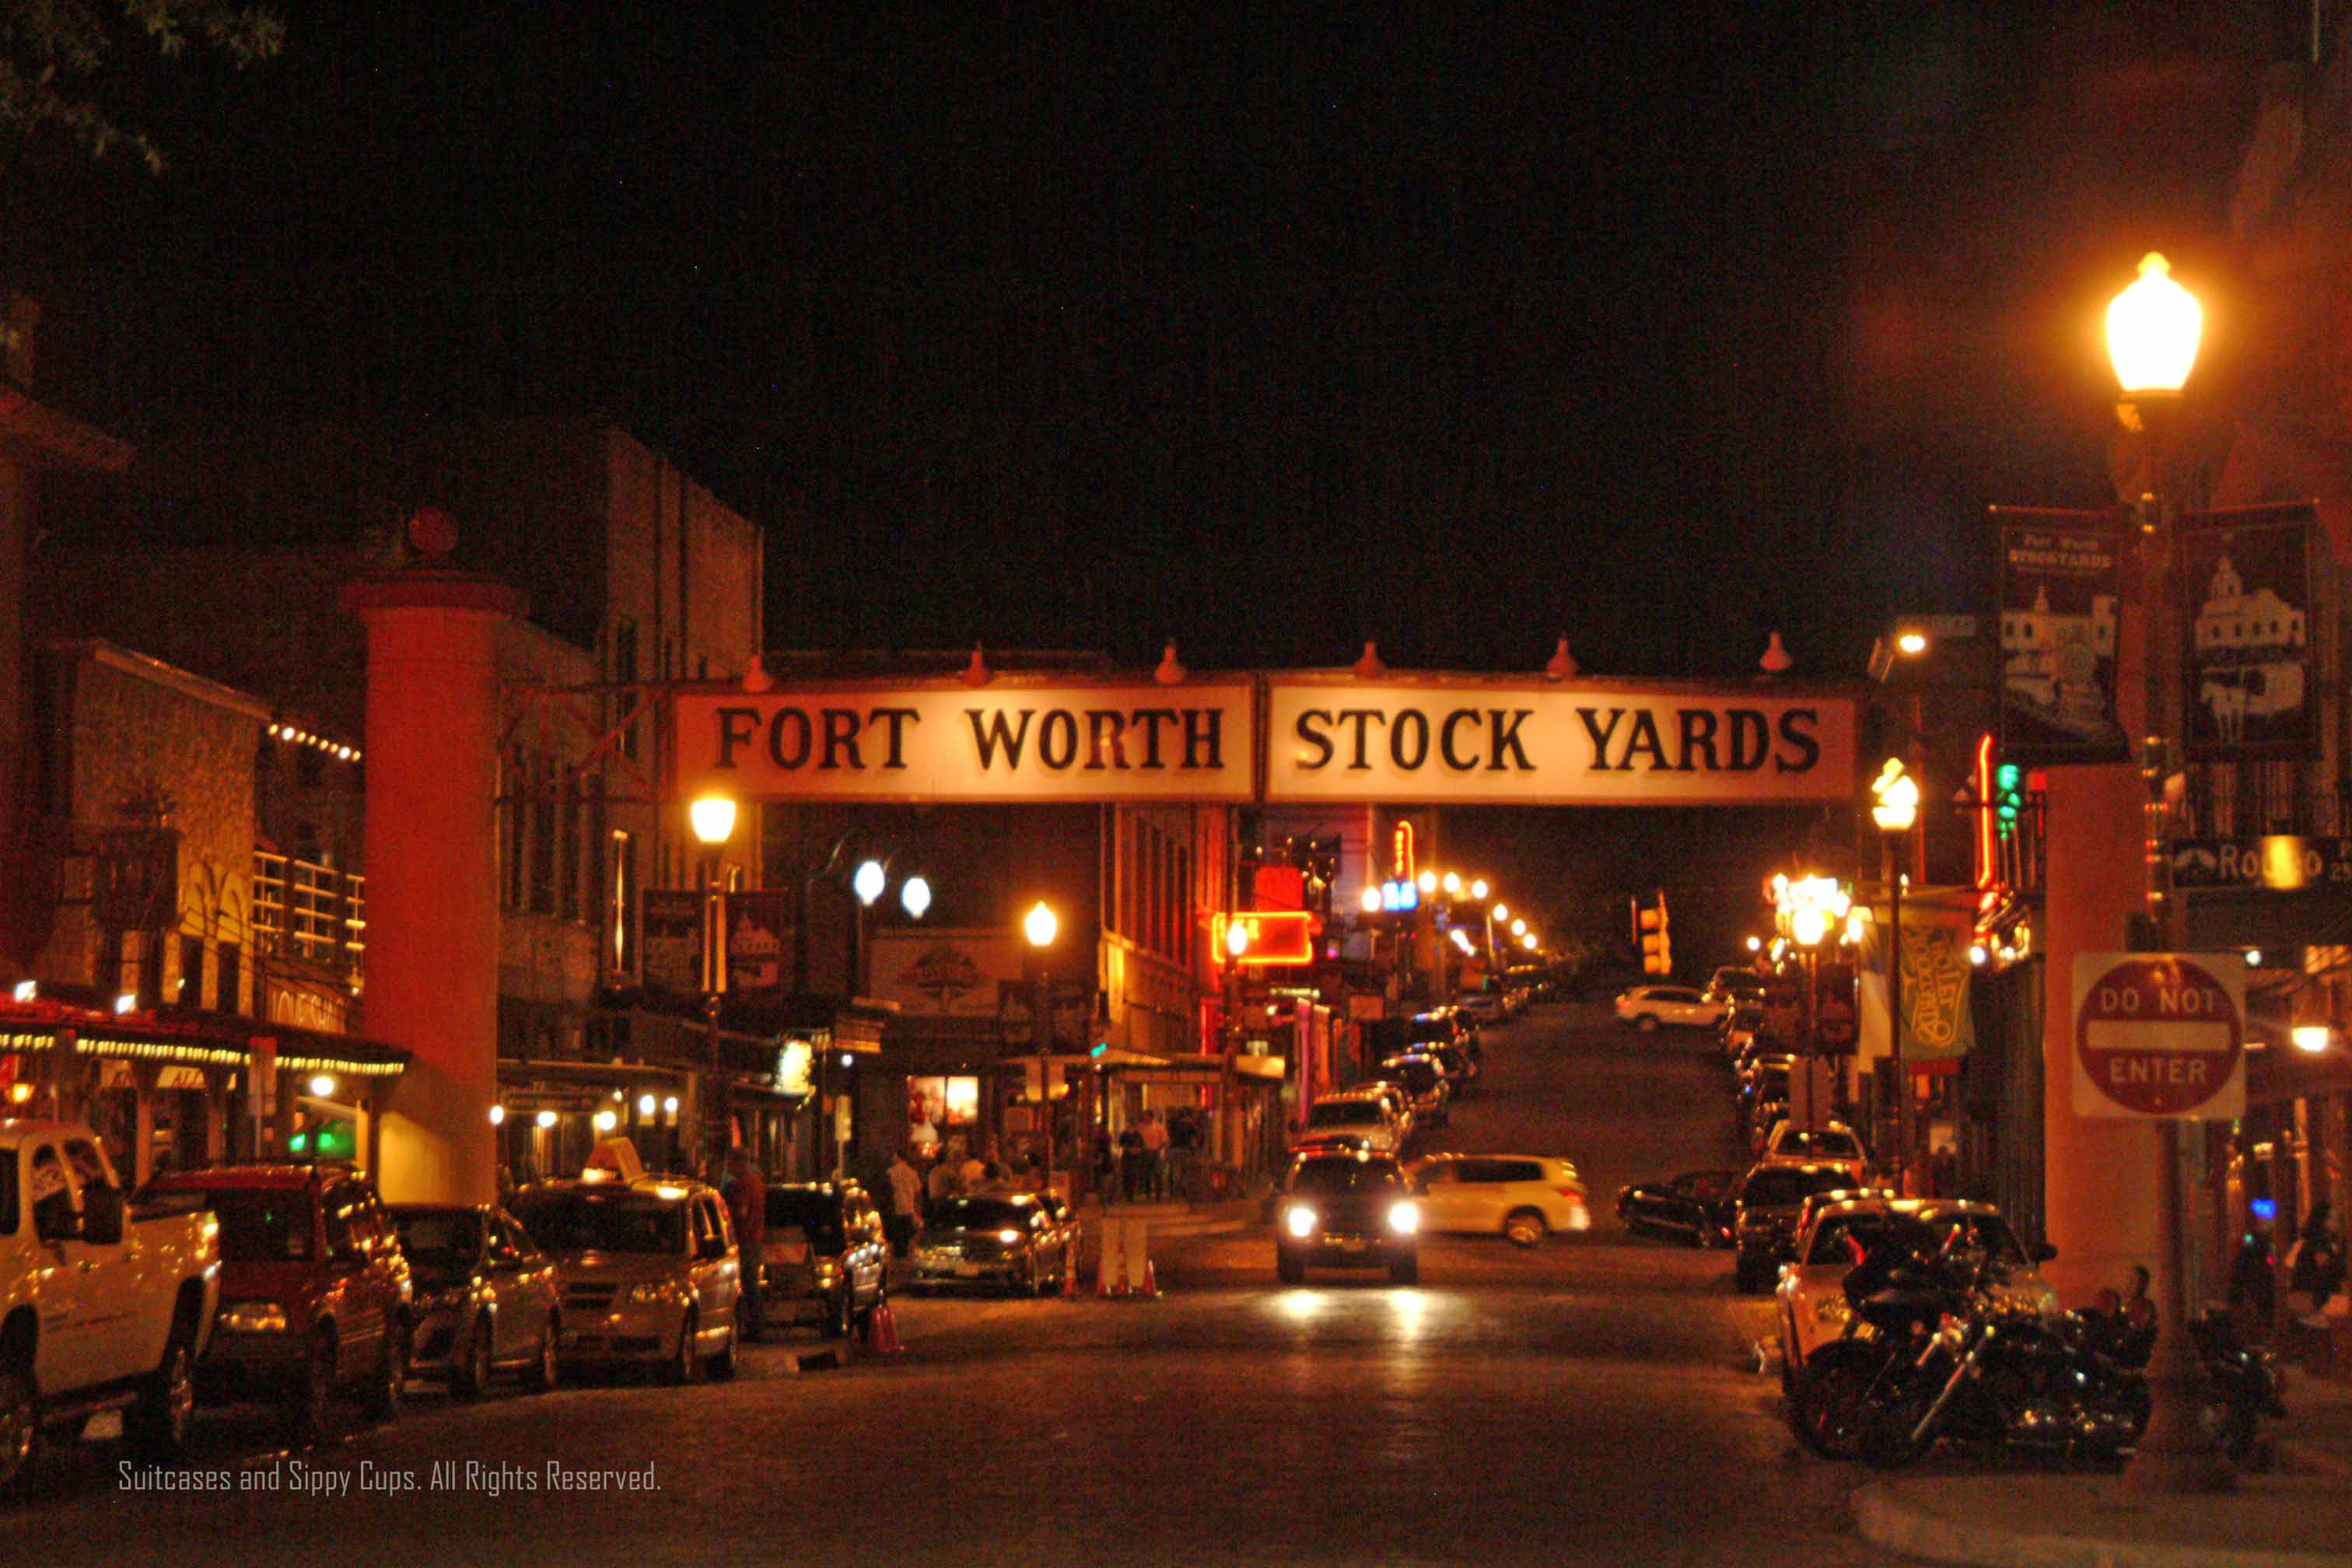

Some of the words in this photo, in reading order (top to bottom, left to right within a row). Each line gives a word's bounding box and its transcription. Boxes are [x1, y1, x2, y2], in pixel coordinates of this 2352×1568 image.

[712, 707, 922, 770] FORT
[964, 708, 1225, 770] WORTH
[1296, 707, 1535, 771] STOCK
[1577, 707, 1820, 773] YARDS
[2102, 987, 2139, 1011] DO
[2160, 986, 2215, 1013] NOT
[2110, 1057, 2207, 1083] ENTER
